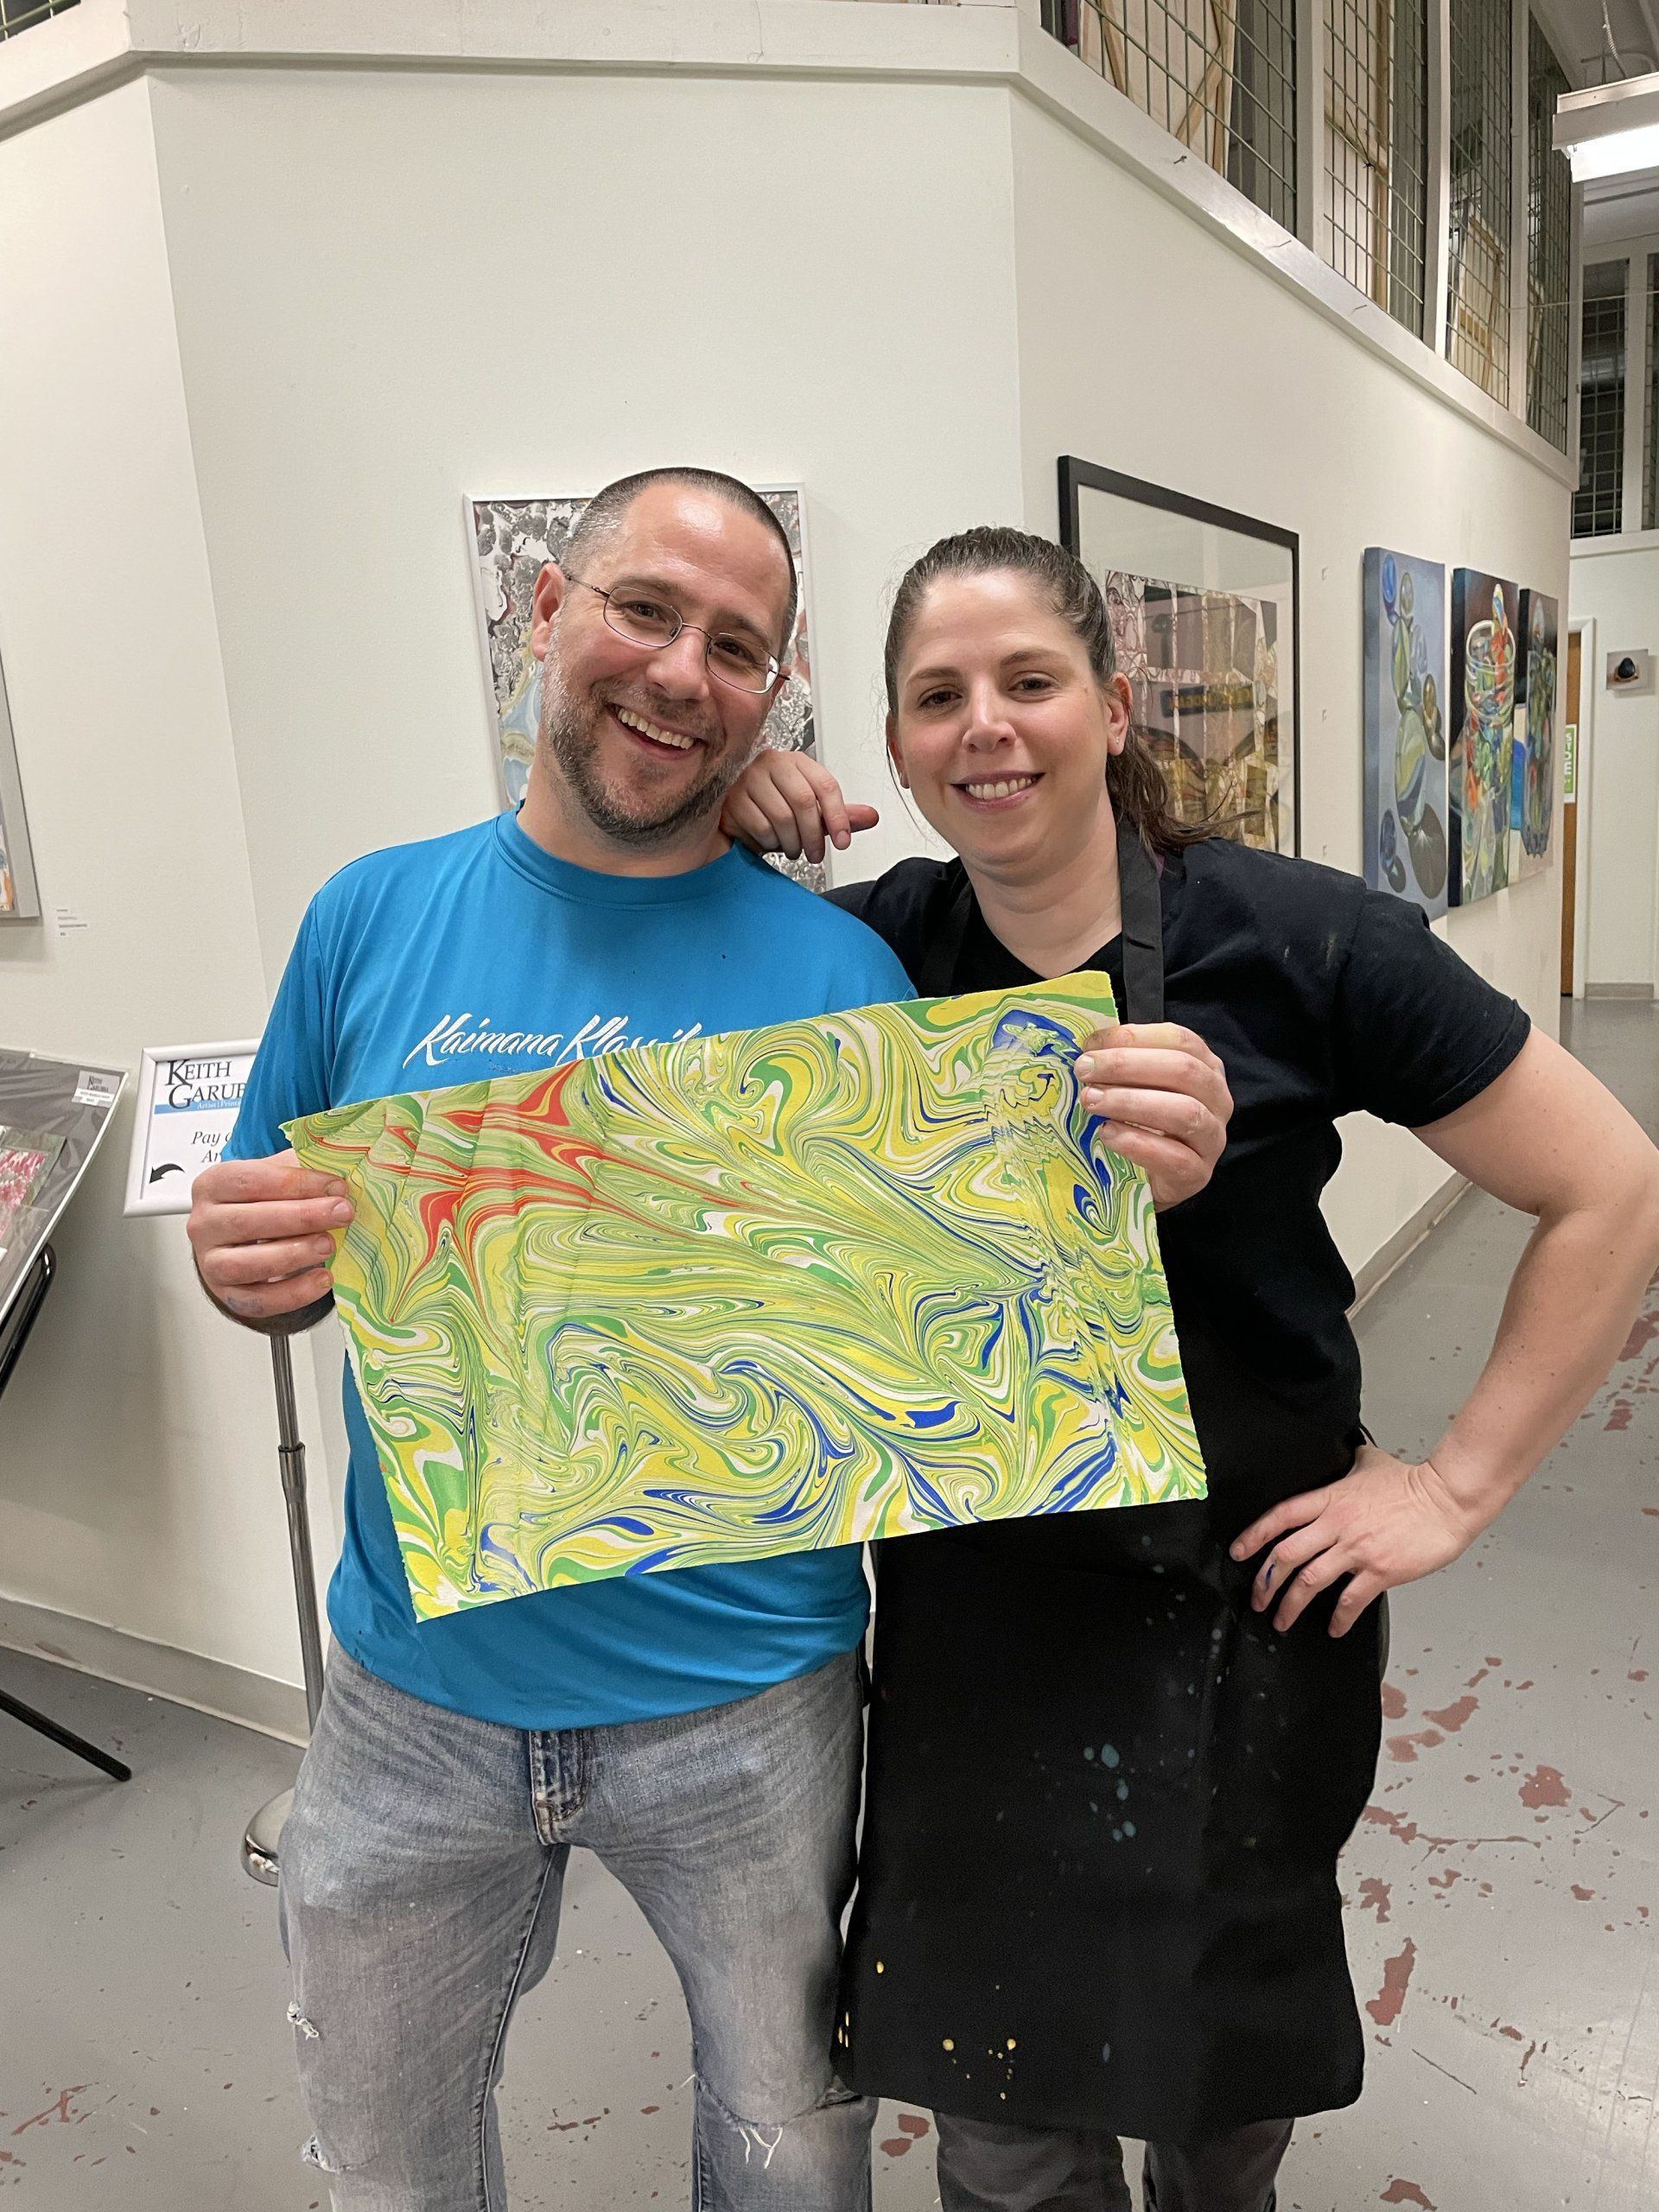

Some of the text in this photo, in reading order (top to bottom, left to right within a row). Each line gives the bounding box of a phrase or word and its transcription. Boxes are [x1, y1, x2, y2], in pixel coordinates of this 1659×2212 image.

[402, 1013, 563, 1069] Kaimana
[164, 1058, 232, 1085] KEITH
[191, 1131, 221, 1147] Pay
